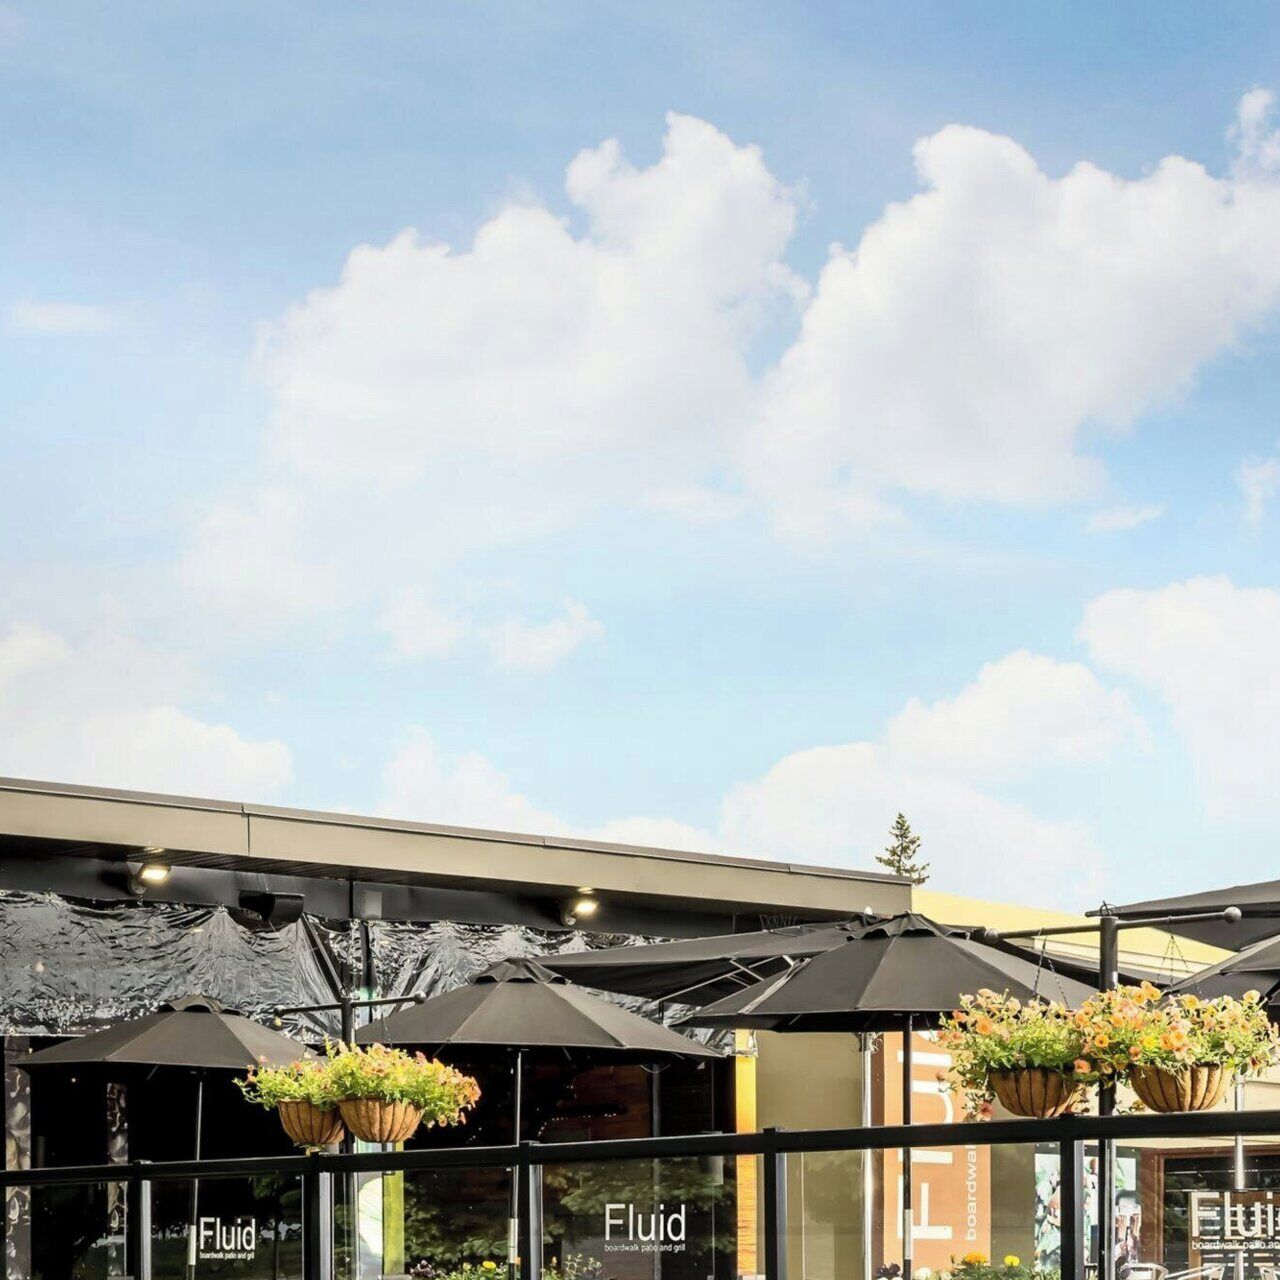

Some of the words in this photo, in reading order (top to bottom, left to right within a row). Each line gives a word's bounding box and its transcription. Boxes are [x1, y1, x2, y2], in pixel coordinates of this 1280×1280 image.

[896, 1031, 954, 1240] Flui
[965, 1145, 977, 1240] boardwal
[200, 1217, 256, 1250] Fluid
[604, 1203, 686, 1241] Fluid
[604, 1243, 640, 1252] boardwalk
[659, 1243, 673, 1252] and
[1192, 1240, 1240, 1250] boardwalk
[1243, 1240, 1266, 1252] patio
